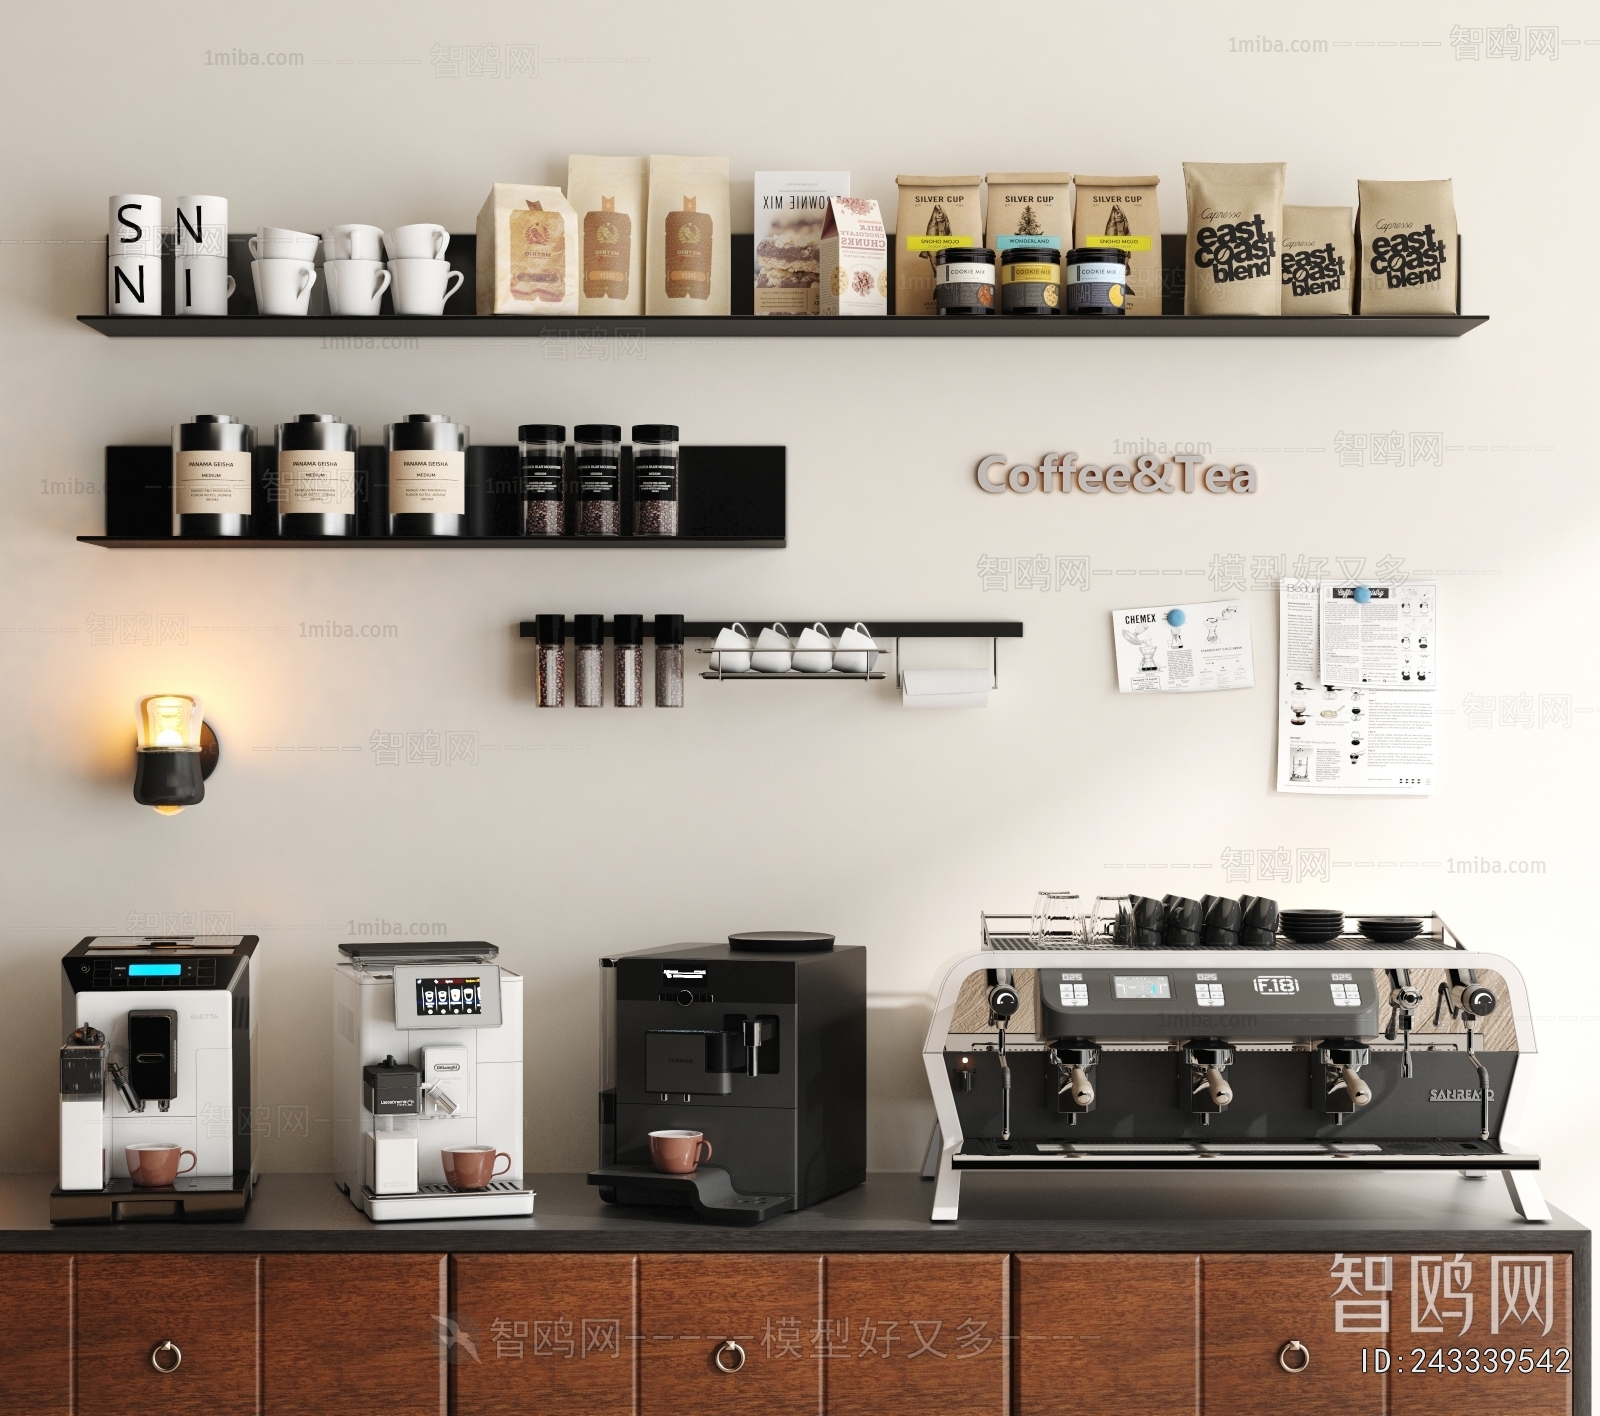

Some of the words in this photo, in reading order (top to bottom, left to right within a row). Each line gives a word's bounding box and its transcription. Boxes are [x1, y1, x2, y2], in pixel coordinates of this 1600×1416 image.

[915, 195, 944, 203] SILVER
[947, 195, 965, 203] CUP
[1005, 195, 1034, 203] SILVER
[1036, 195, 1054, 203] CUP
[1093, 195, 1122, 203] SILVER
[1125, 195, 1142, 203] CUP
[117, 203, 143, 243] S
[176, 205, 203, 245] N
[1200, 207, 1242, 222] Capresso
[1373, 219, 1414, 232] Capresso
[1196, 214, 1265, 248] east
[1282, 238, 1316, 248] Capresso
[1372, 224, 1435, 257] east
[1194, 231, 1276, 268] coast
[1281, 243, 1336, 269] east
[1370, 240, 1446, 274] coast
[1213, 256, 1271, 284] blend
[1281, 255, 1346, 284] coast
[1387, 262, 1442, 289] blend
[114, 265, 145, 304] N
[1292, 275, 1341, 297] blend
[974, 452, 1258, 495] Coffee&Tea
[1125, 613, 1156, 625] CHEMEX
